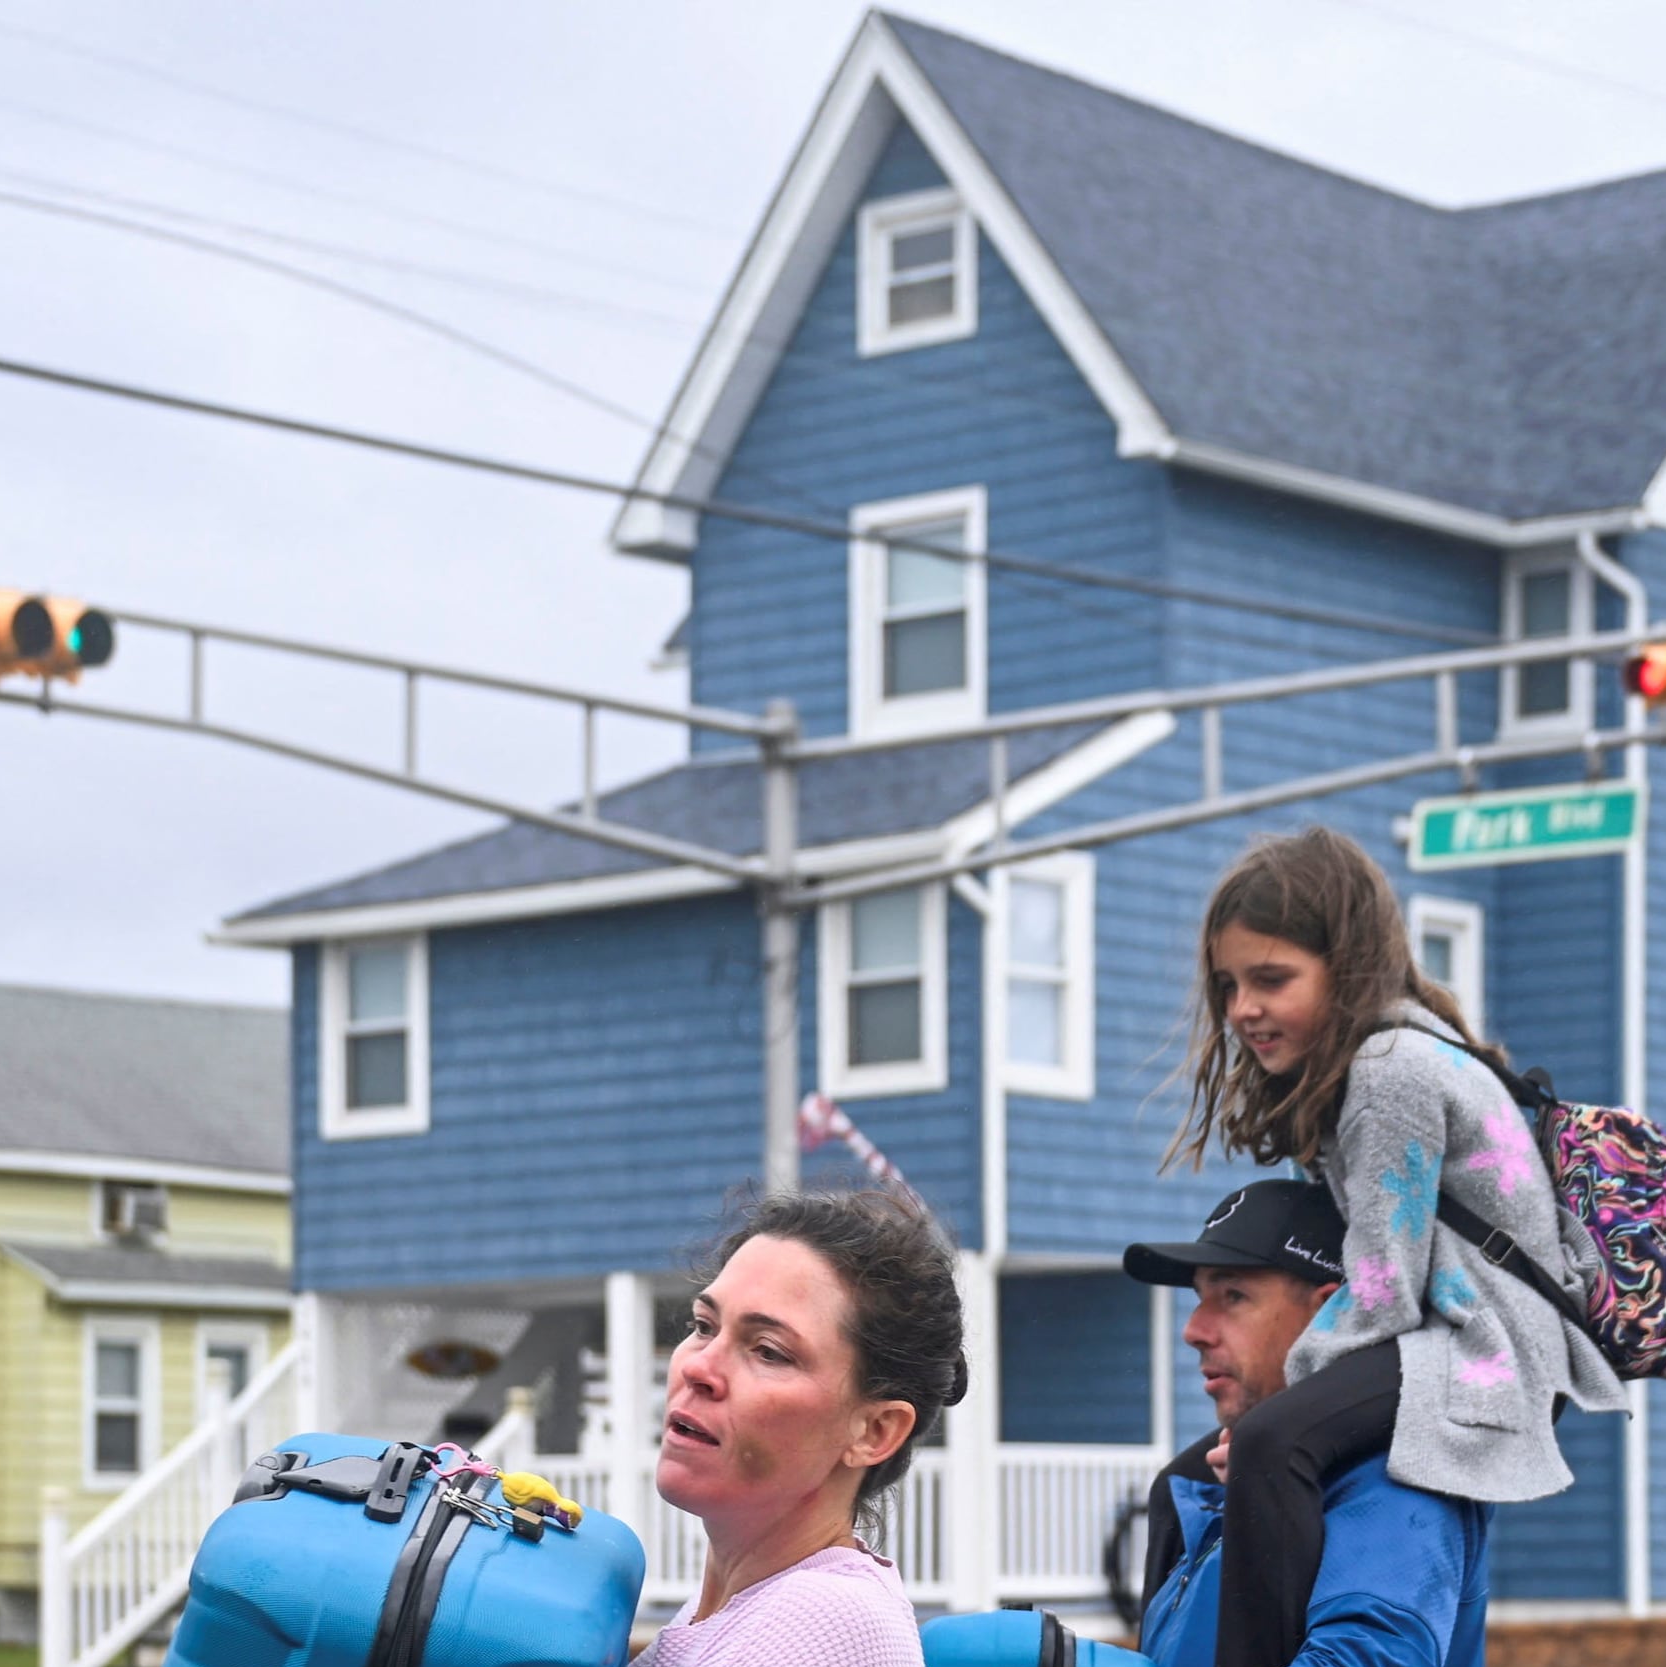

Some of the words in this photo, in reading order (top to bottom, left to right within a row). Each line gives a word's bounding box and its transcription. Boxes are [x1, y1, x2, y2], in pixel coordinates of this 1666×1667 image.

[1451, 806, 1532, 851] Park
[1547, 799, 1605, 833] Blvd
[1284, 1235, 1311, 1260] Live
[1312, 1248, 1344, 1273] Luck
